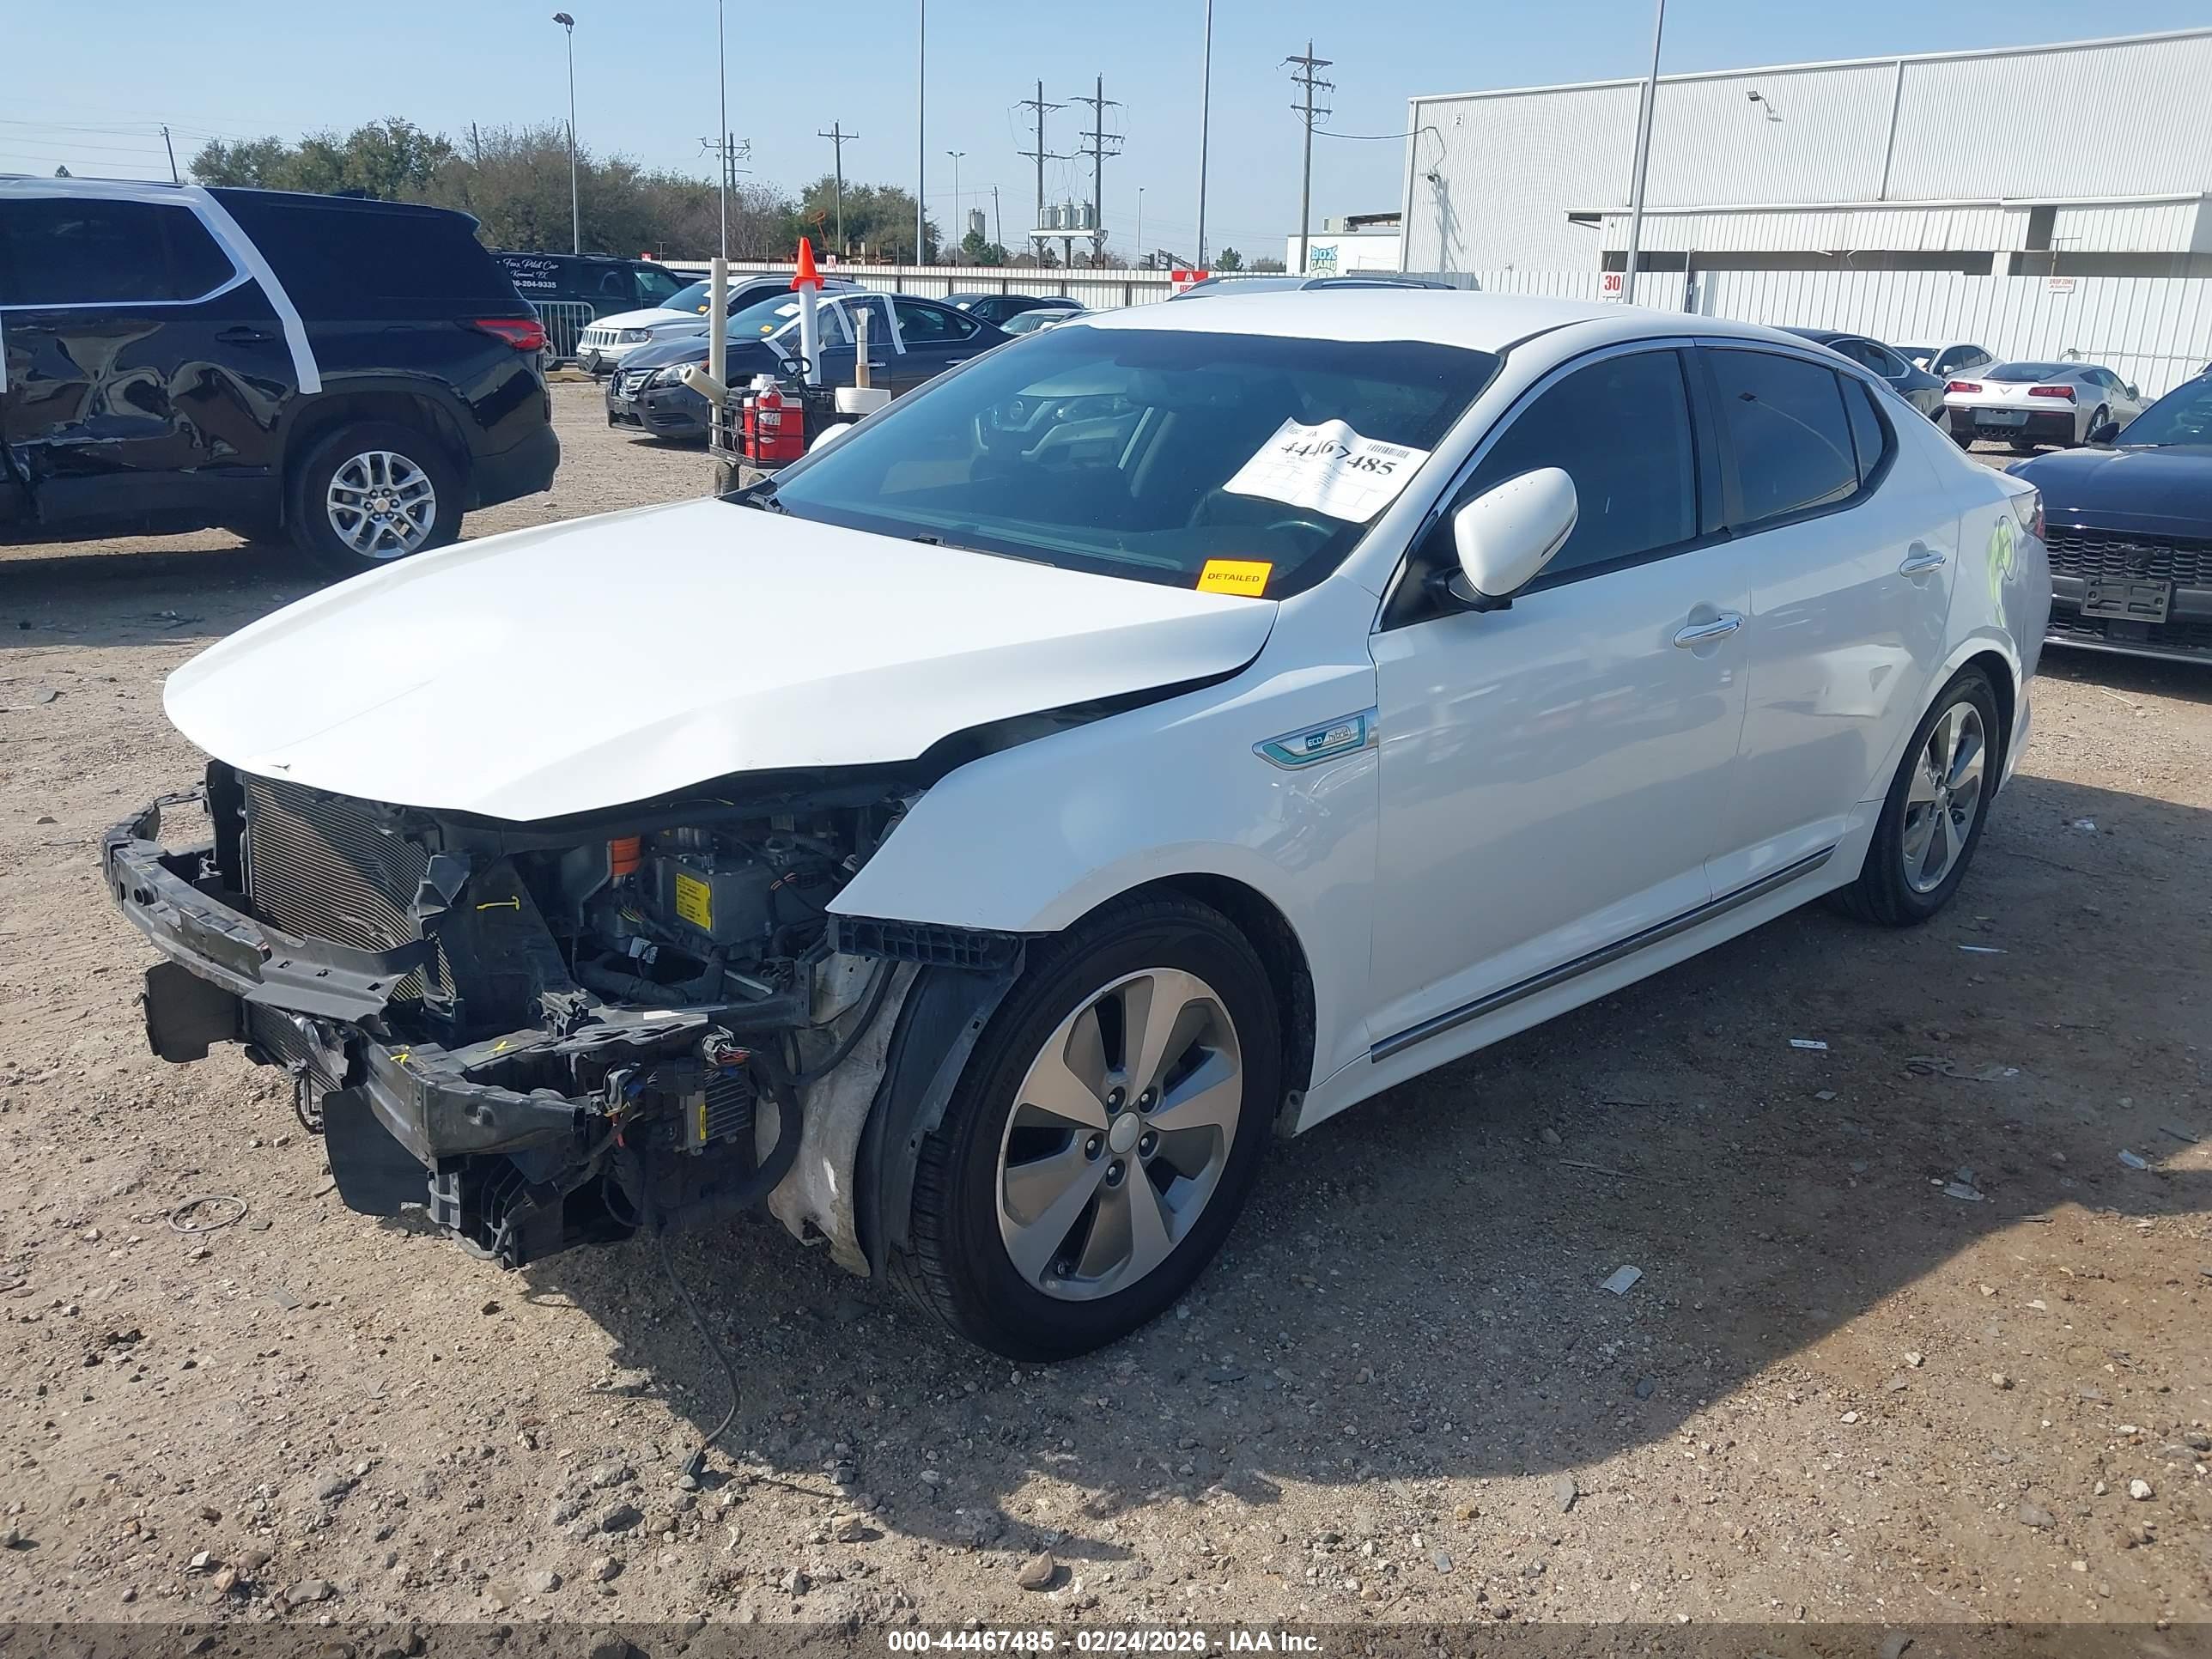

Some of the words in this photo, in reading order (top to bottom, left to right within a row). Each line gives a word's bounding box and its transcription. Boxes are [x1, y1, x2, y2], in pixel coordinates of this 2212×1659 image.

[1310, 244, 1338, 260] BOX
[543, 259, 559, 270] Car
[1604, 275, 1621, 291] 30
[1207, 573, 1260, 583] DETAILED
[1307, 735, 1322, 748] ECO
[1328, 727, 1349, 743] hybrid
